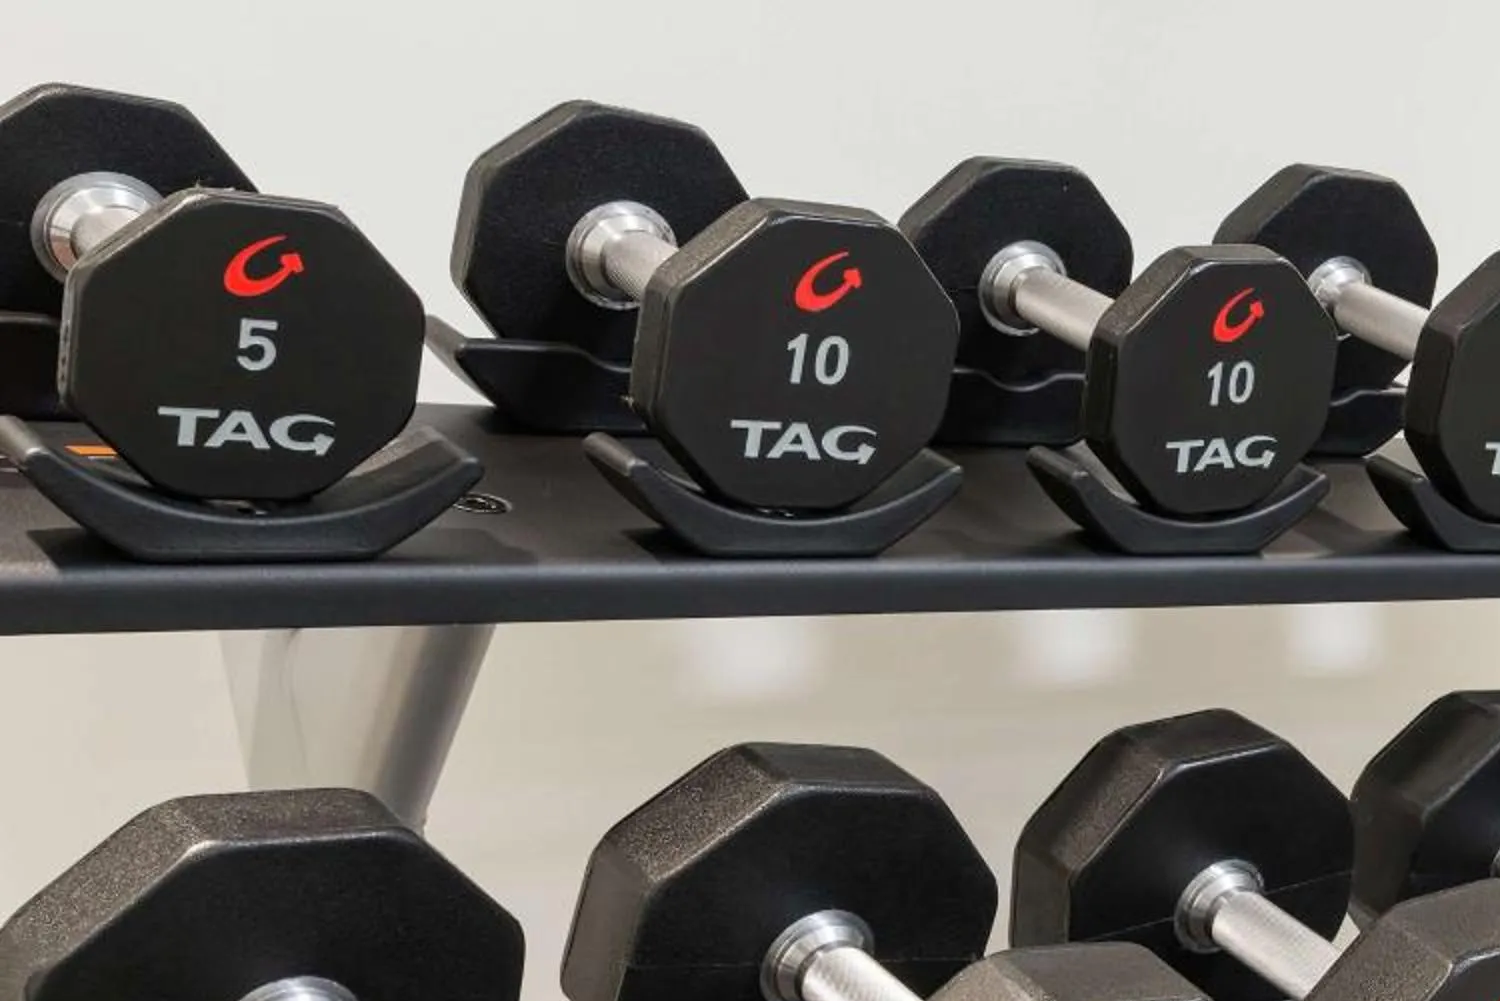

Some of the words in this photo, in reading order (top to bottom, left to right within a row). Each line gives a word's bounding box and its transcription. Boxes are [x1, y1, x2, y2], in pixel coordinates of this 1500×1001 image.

[237, 317, 279, 371] 5
[787, 333, 850, 386] 10
[1207, 360, 1255, 406] 10
[157, 406, 335, 456] TAG
[730, 419, 877, 465] TAG
[1165, 435, 1277, 473] TAG
